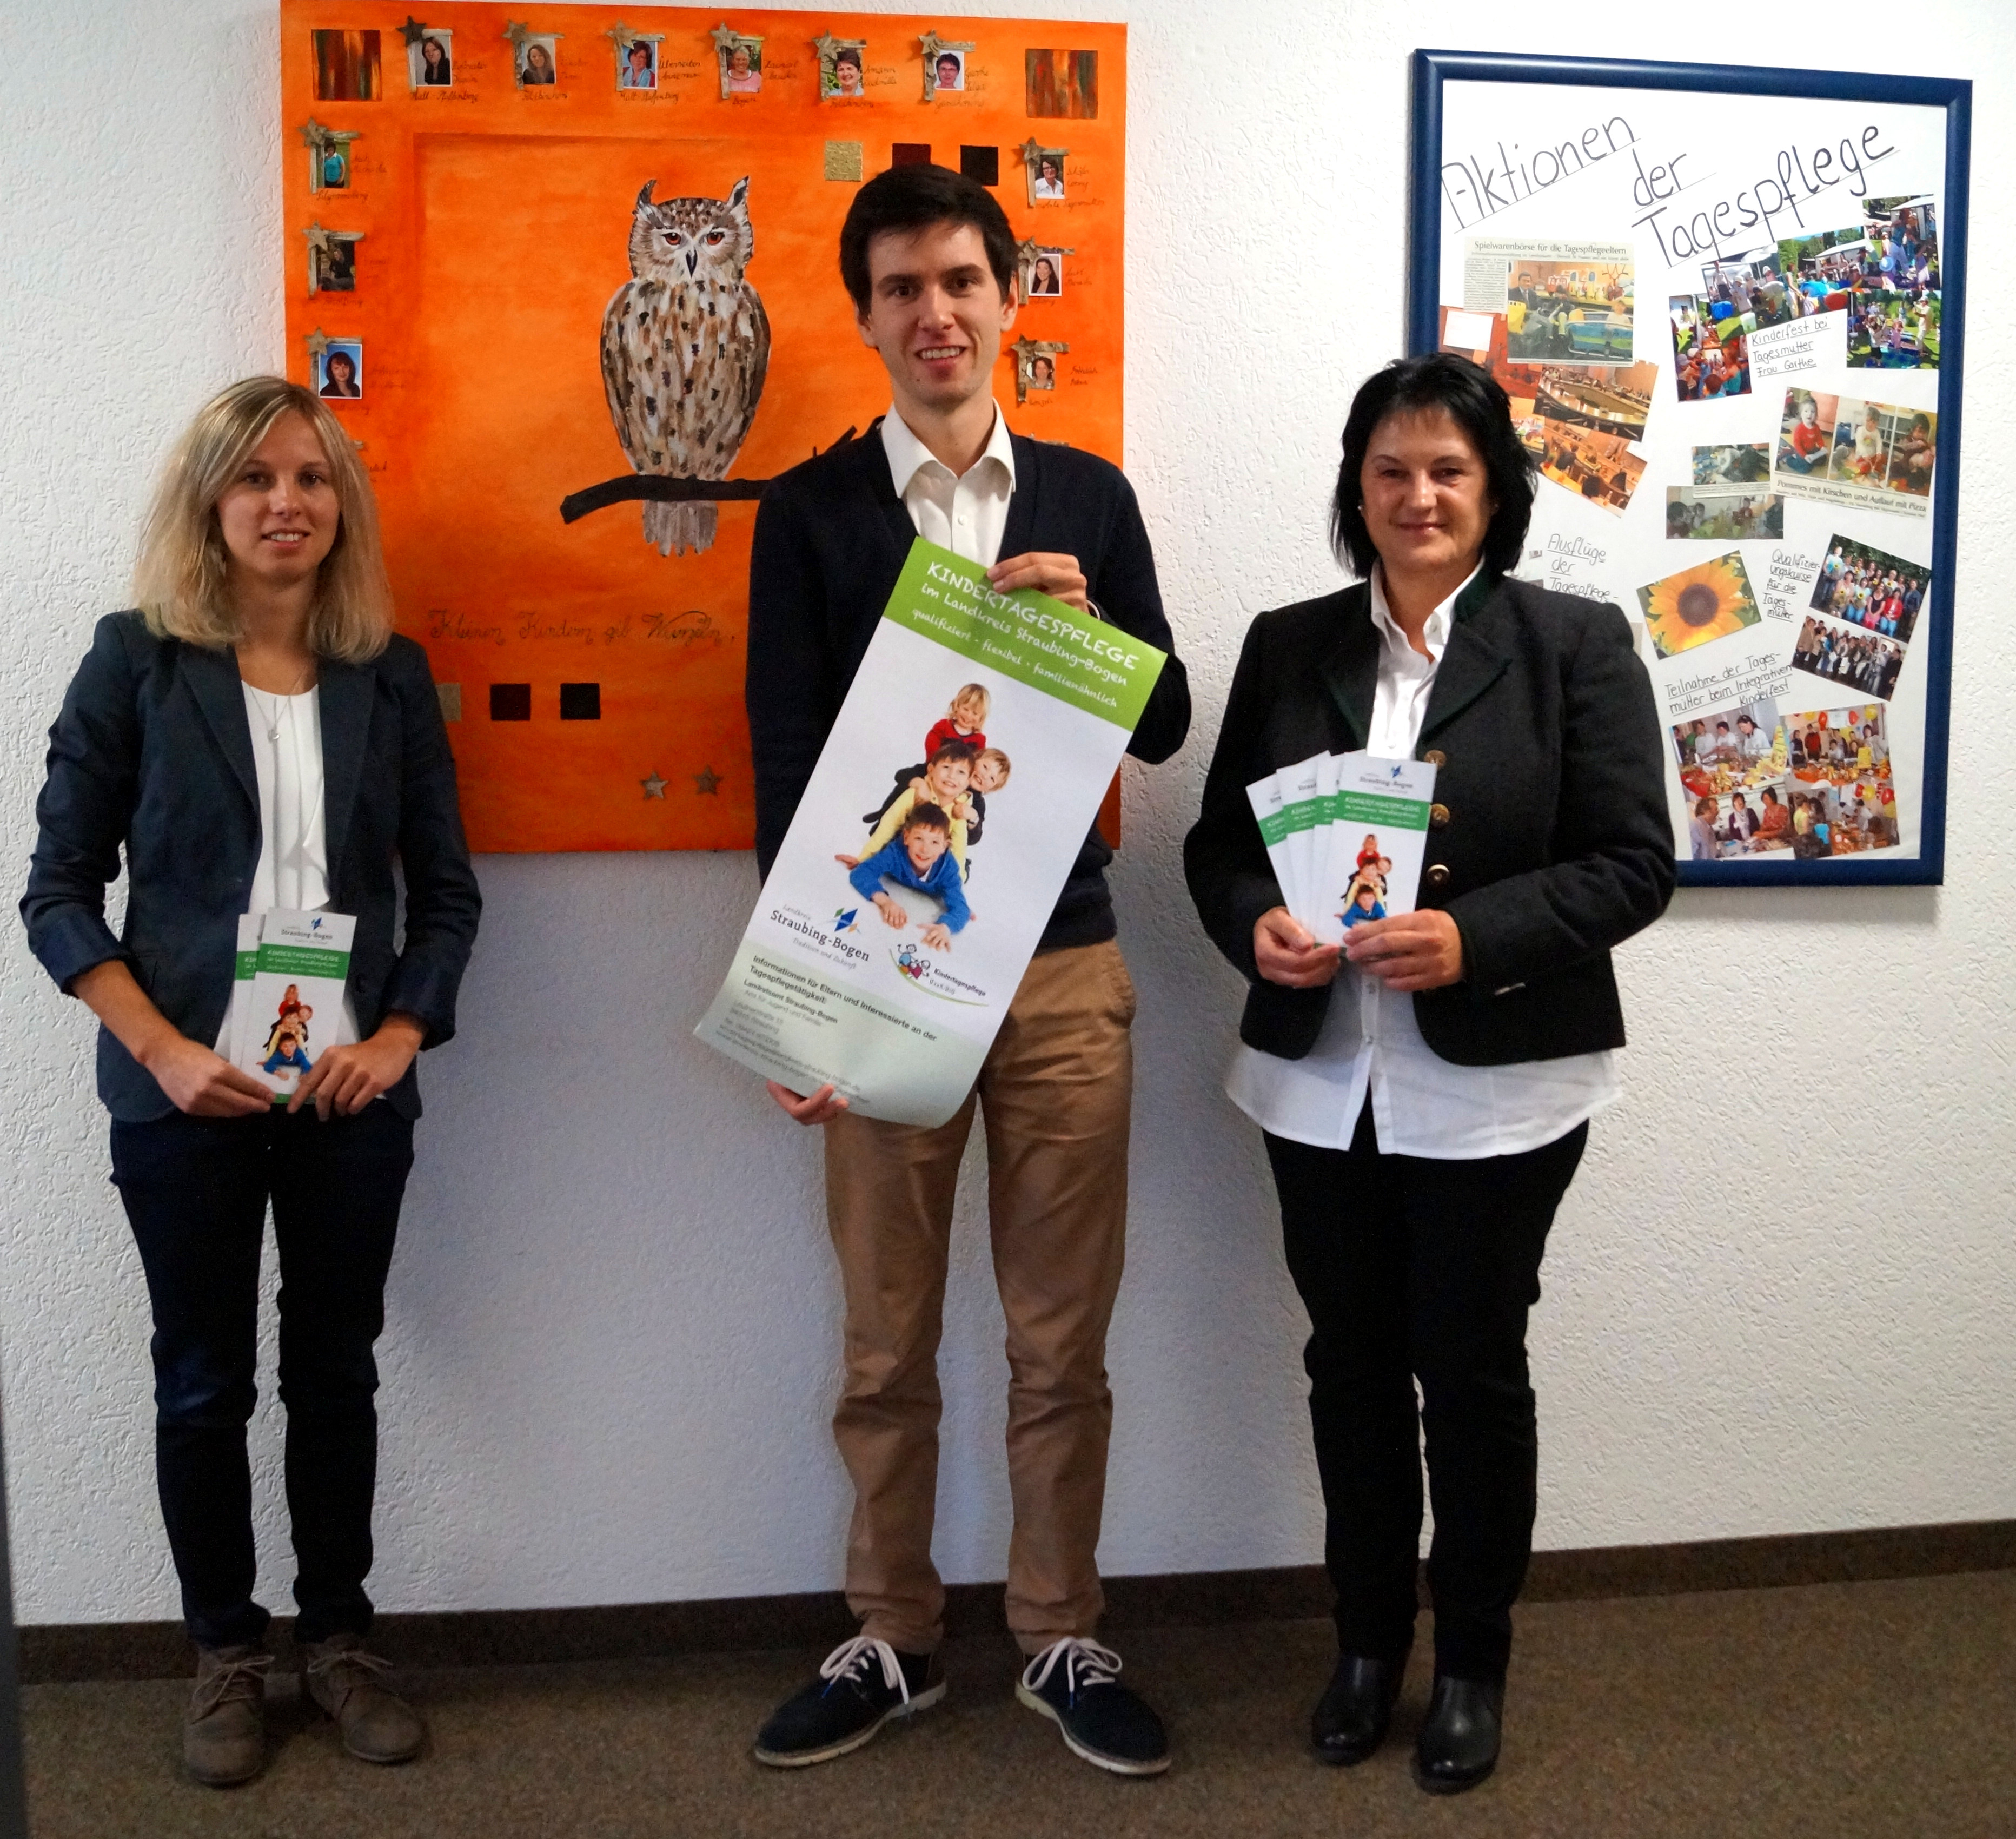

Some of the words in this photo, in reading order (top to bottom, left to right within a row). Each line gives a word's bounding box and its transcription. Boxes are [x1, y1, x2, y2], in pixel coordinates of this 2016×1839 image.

[1442, 116, 1635, 229] Aktionen
[1632, 125, 1894, 268] Tagespflege
[1633, 149, 1687, 207] der
[1475, 241, 1535, 252] Spielwarenbörse
[1537, 243, 1548, 251] für
[1550, 244, 1562, 252] die
[1752, 320, 1809, 345] Kinderfest
[1814, 316, 1828, 330] bei
[1753, 341, 1814, 364] Tagesmutter
[1756, 366, 1778, 376] Frau
[1548, 533, 1606, 566] Ausflüge
[1551, 557, 1576, 573] der
[921, 582, 939, 599] im
[944, 593, 1011, 634] Landkreis
[1016, 627, 1128, 686] Straubing-Bogen
[927, 561, 1140, 670] KINDERTAGESPFLEGE
[912, 607, 972, 642] qualifiziert
[982, 640, 1022, 665] flexibel
[1033, 664, 1117, 708] familienähnlich
[1664, 674, 1719, 698] Teilnahme
[1722, 665, 1740, 679] der
[1745, 653, 1781, 671] Tages-
[1669, 694, 1705, 715] mütter
[1709, 686, 1733, 701] beim
[1736, 665, 1793, 689] Integrativen
[1739, 678, 1789, 706] Kinderfest
[770, 910, 870, 962] Straubing-Bogen
[753, 955, 806, 983] Informationen
[807, 978, 819, 988] für
[819, 983, 842, 999] Eltern
[844, 995, 859, 1007] und
[860, 1001, 910, 1030] Interessierte
[911, 1026, 921, 1035] an
[923, 1030, 937, 1041] der
